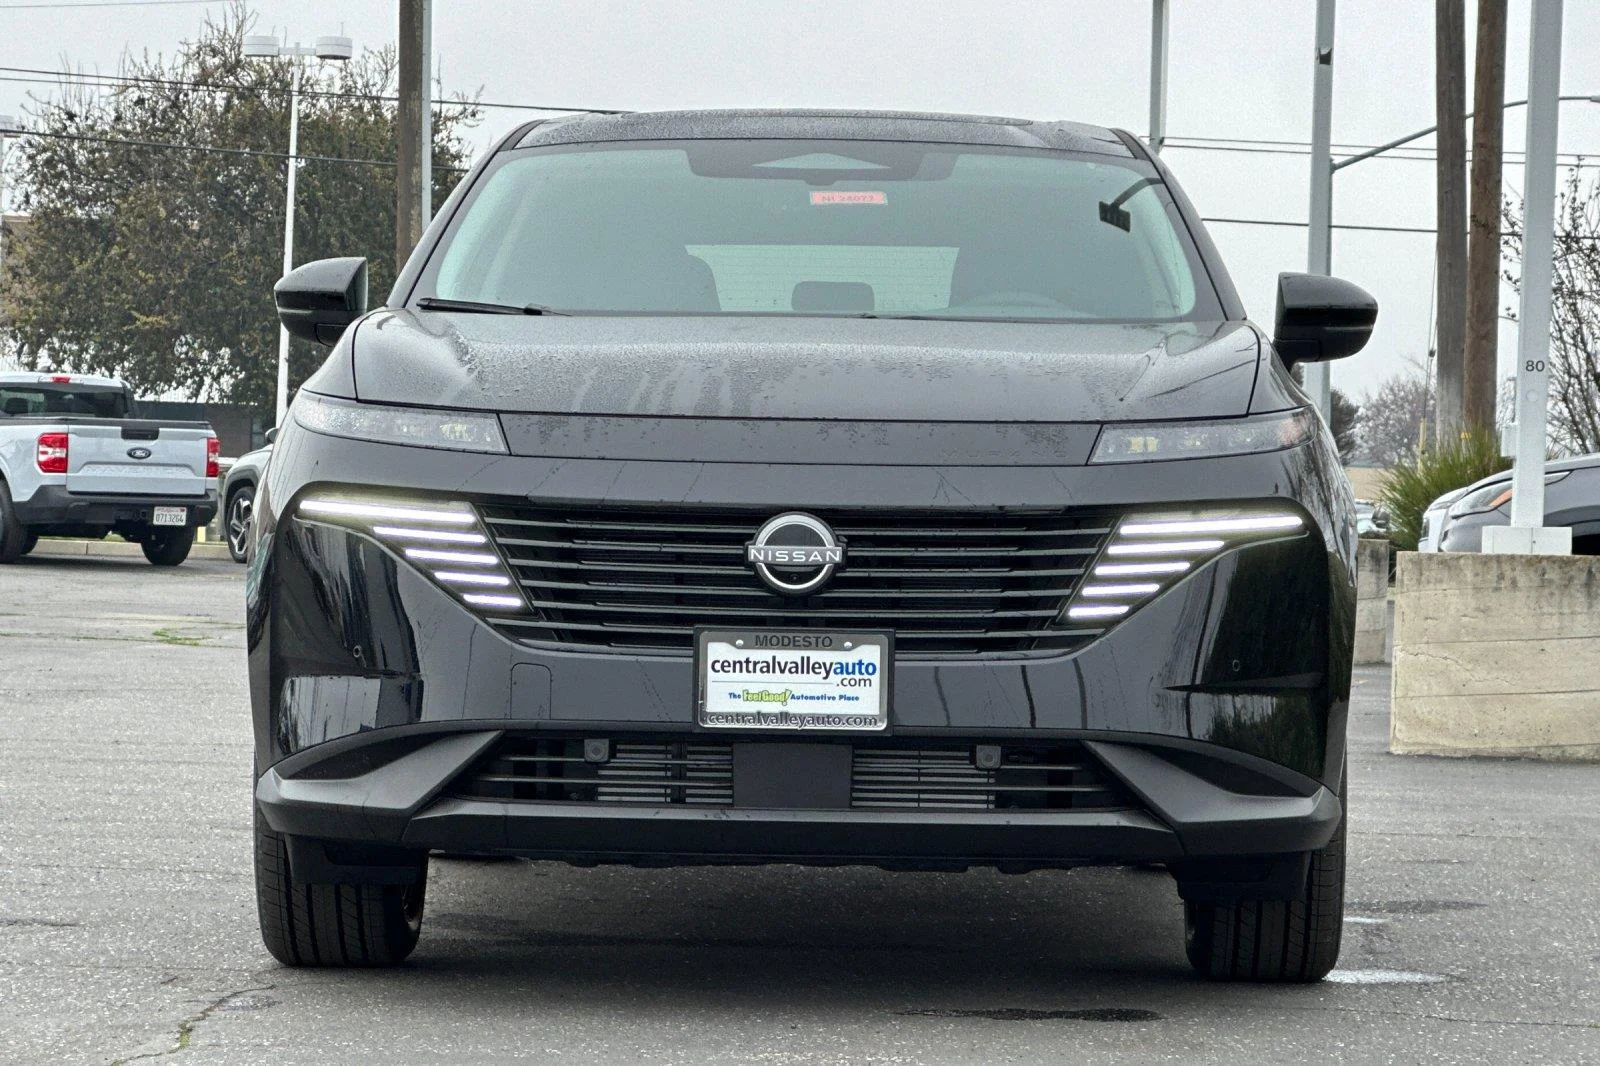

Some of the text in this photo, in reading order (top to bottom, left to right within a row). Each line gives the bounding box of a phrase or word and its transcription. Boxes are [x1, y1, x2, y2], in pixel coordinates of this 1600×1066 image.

[1525, 360, 1546, 372] 80
[750, 548, 841, 562] NISSAN
[755, 634, 833, 648] MODESTO
[710, 655, 878, 680] centralvalleyauto
[836, 676, 873, 688] .com
[790, 693, 837, 701] Automotive
[838, 693, 860, 701] Place
[708, 711, 879, 730] centralvalleyauto.com
